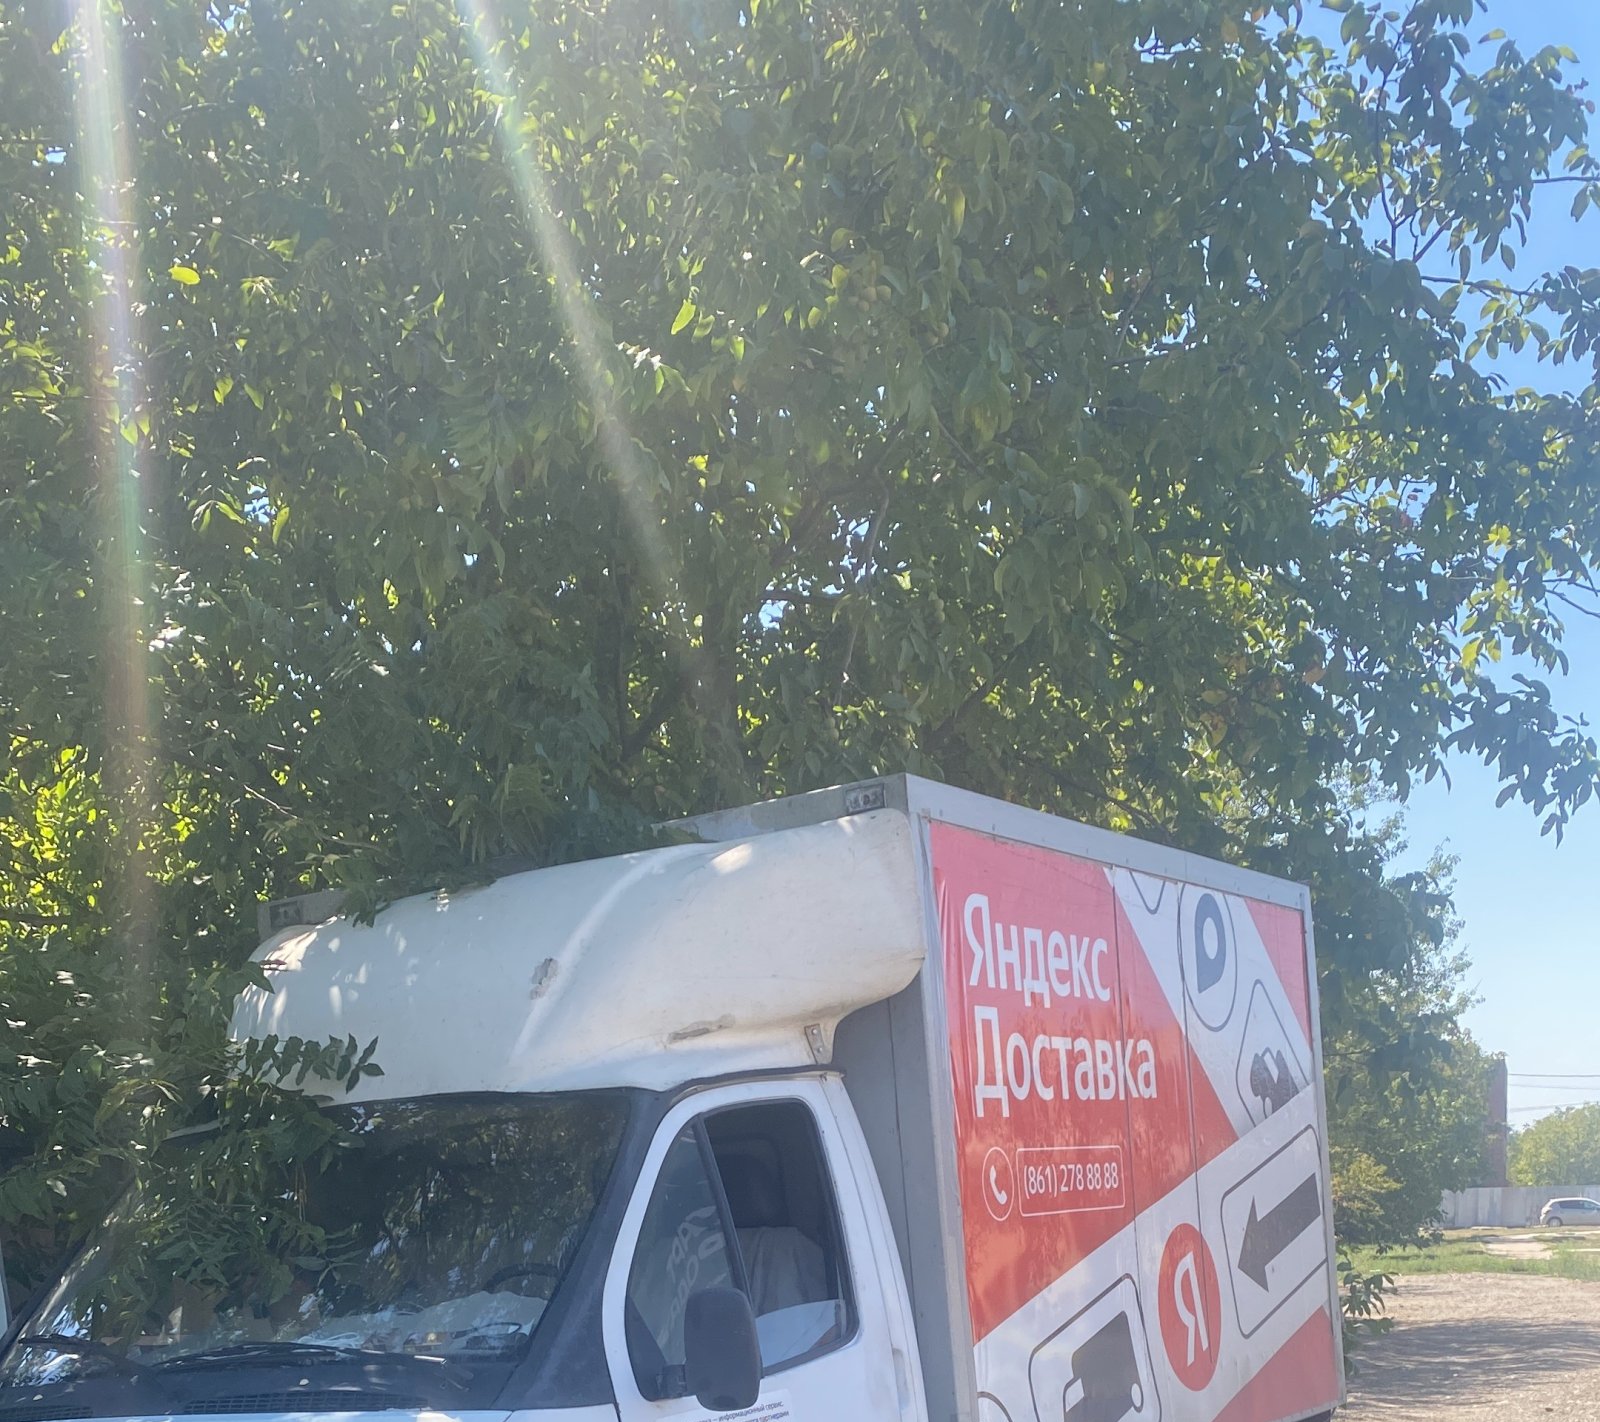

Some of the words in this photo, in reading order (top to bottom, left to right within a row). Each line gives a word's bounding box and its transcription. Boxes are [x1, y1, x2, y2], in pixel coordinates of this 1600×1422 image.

[964, 893, 1111, 1008] Яндекс
[974, 1005, 1158, 1118] Доставка
[1023, 1164, 1058, 1200] (861)
[1060, 1164, 1085, 1192] 278
[1086, 1162, 1102, 1190] 88
[1103, 1162, 1119, 1189] 88
[1174, 1251, 1209, 1368] Я
[718, 1404, 765, 1422] информационный
